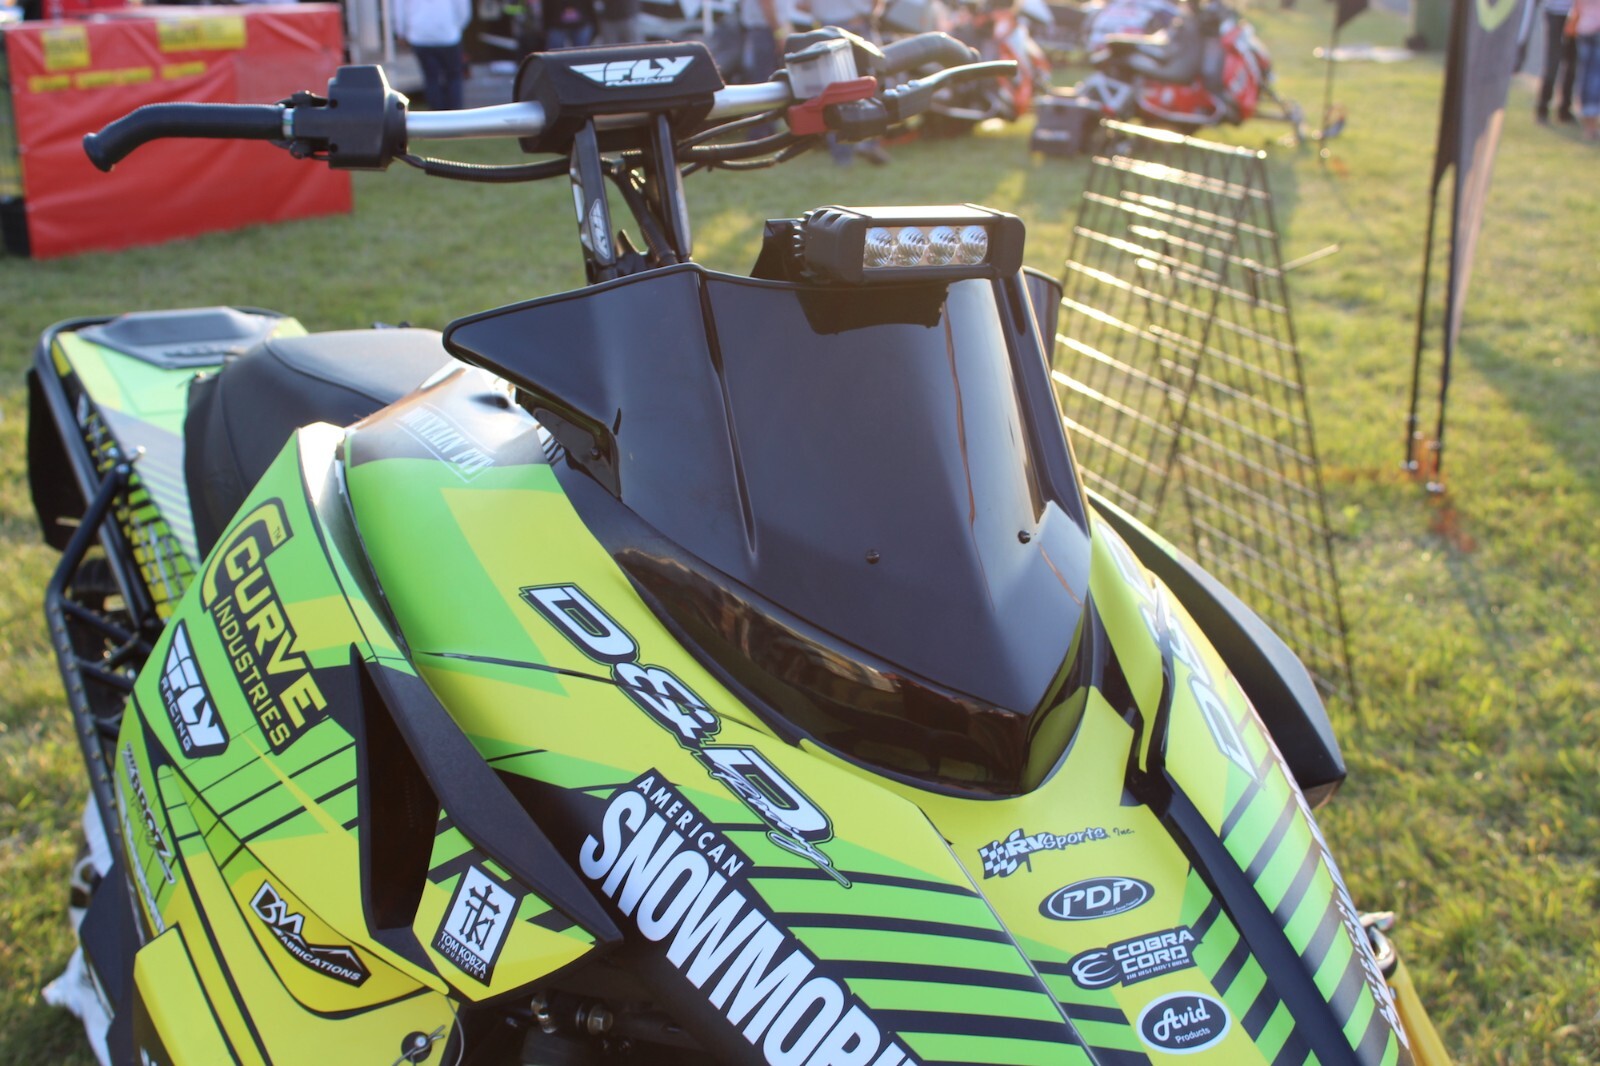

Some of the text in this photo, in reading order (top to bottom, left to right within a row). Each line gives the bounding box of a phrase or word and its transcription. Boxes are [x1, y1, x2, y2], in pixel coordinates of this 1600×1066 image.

[569, 56, 695, 83] FLY
[225, 536, 328, 729] CURVE
[166, 624, 226, 747] FLY
[214, 595, 291, 747] INDUSTRIES
[160, 676, 191, 751] RACING
[636, 775, 744, 877] AMERICAN
[1063, 880, 1135, 917] PDP
[271, 926, 362, 981] FABRICATIONS
[437, 941, 485, 979] INDUSTRIES
[440, 931, 487, 974] TOM KOBZA
[1112, 929, 1196, 961] COBRA
[1121, 945, 1188, 974] CORD
[1153, 998, 1211, 1042] Avid
[1175, 1026, 1211, 1044] Products
